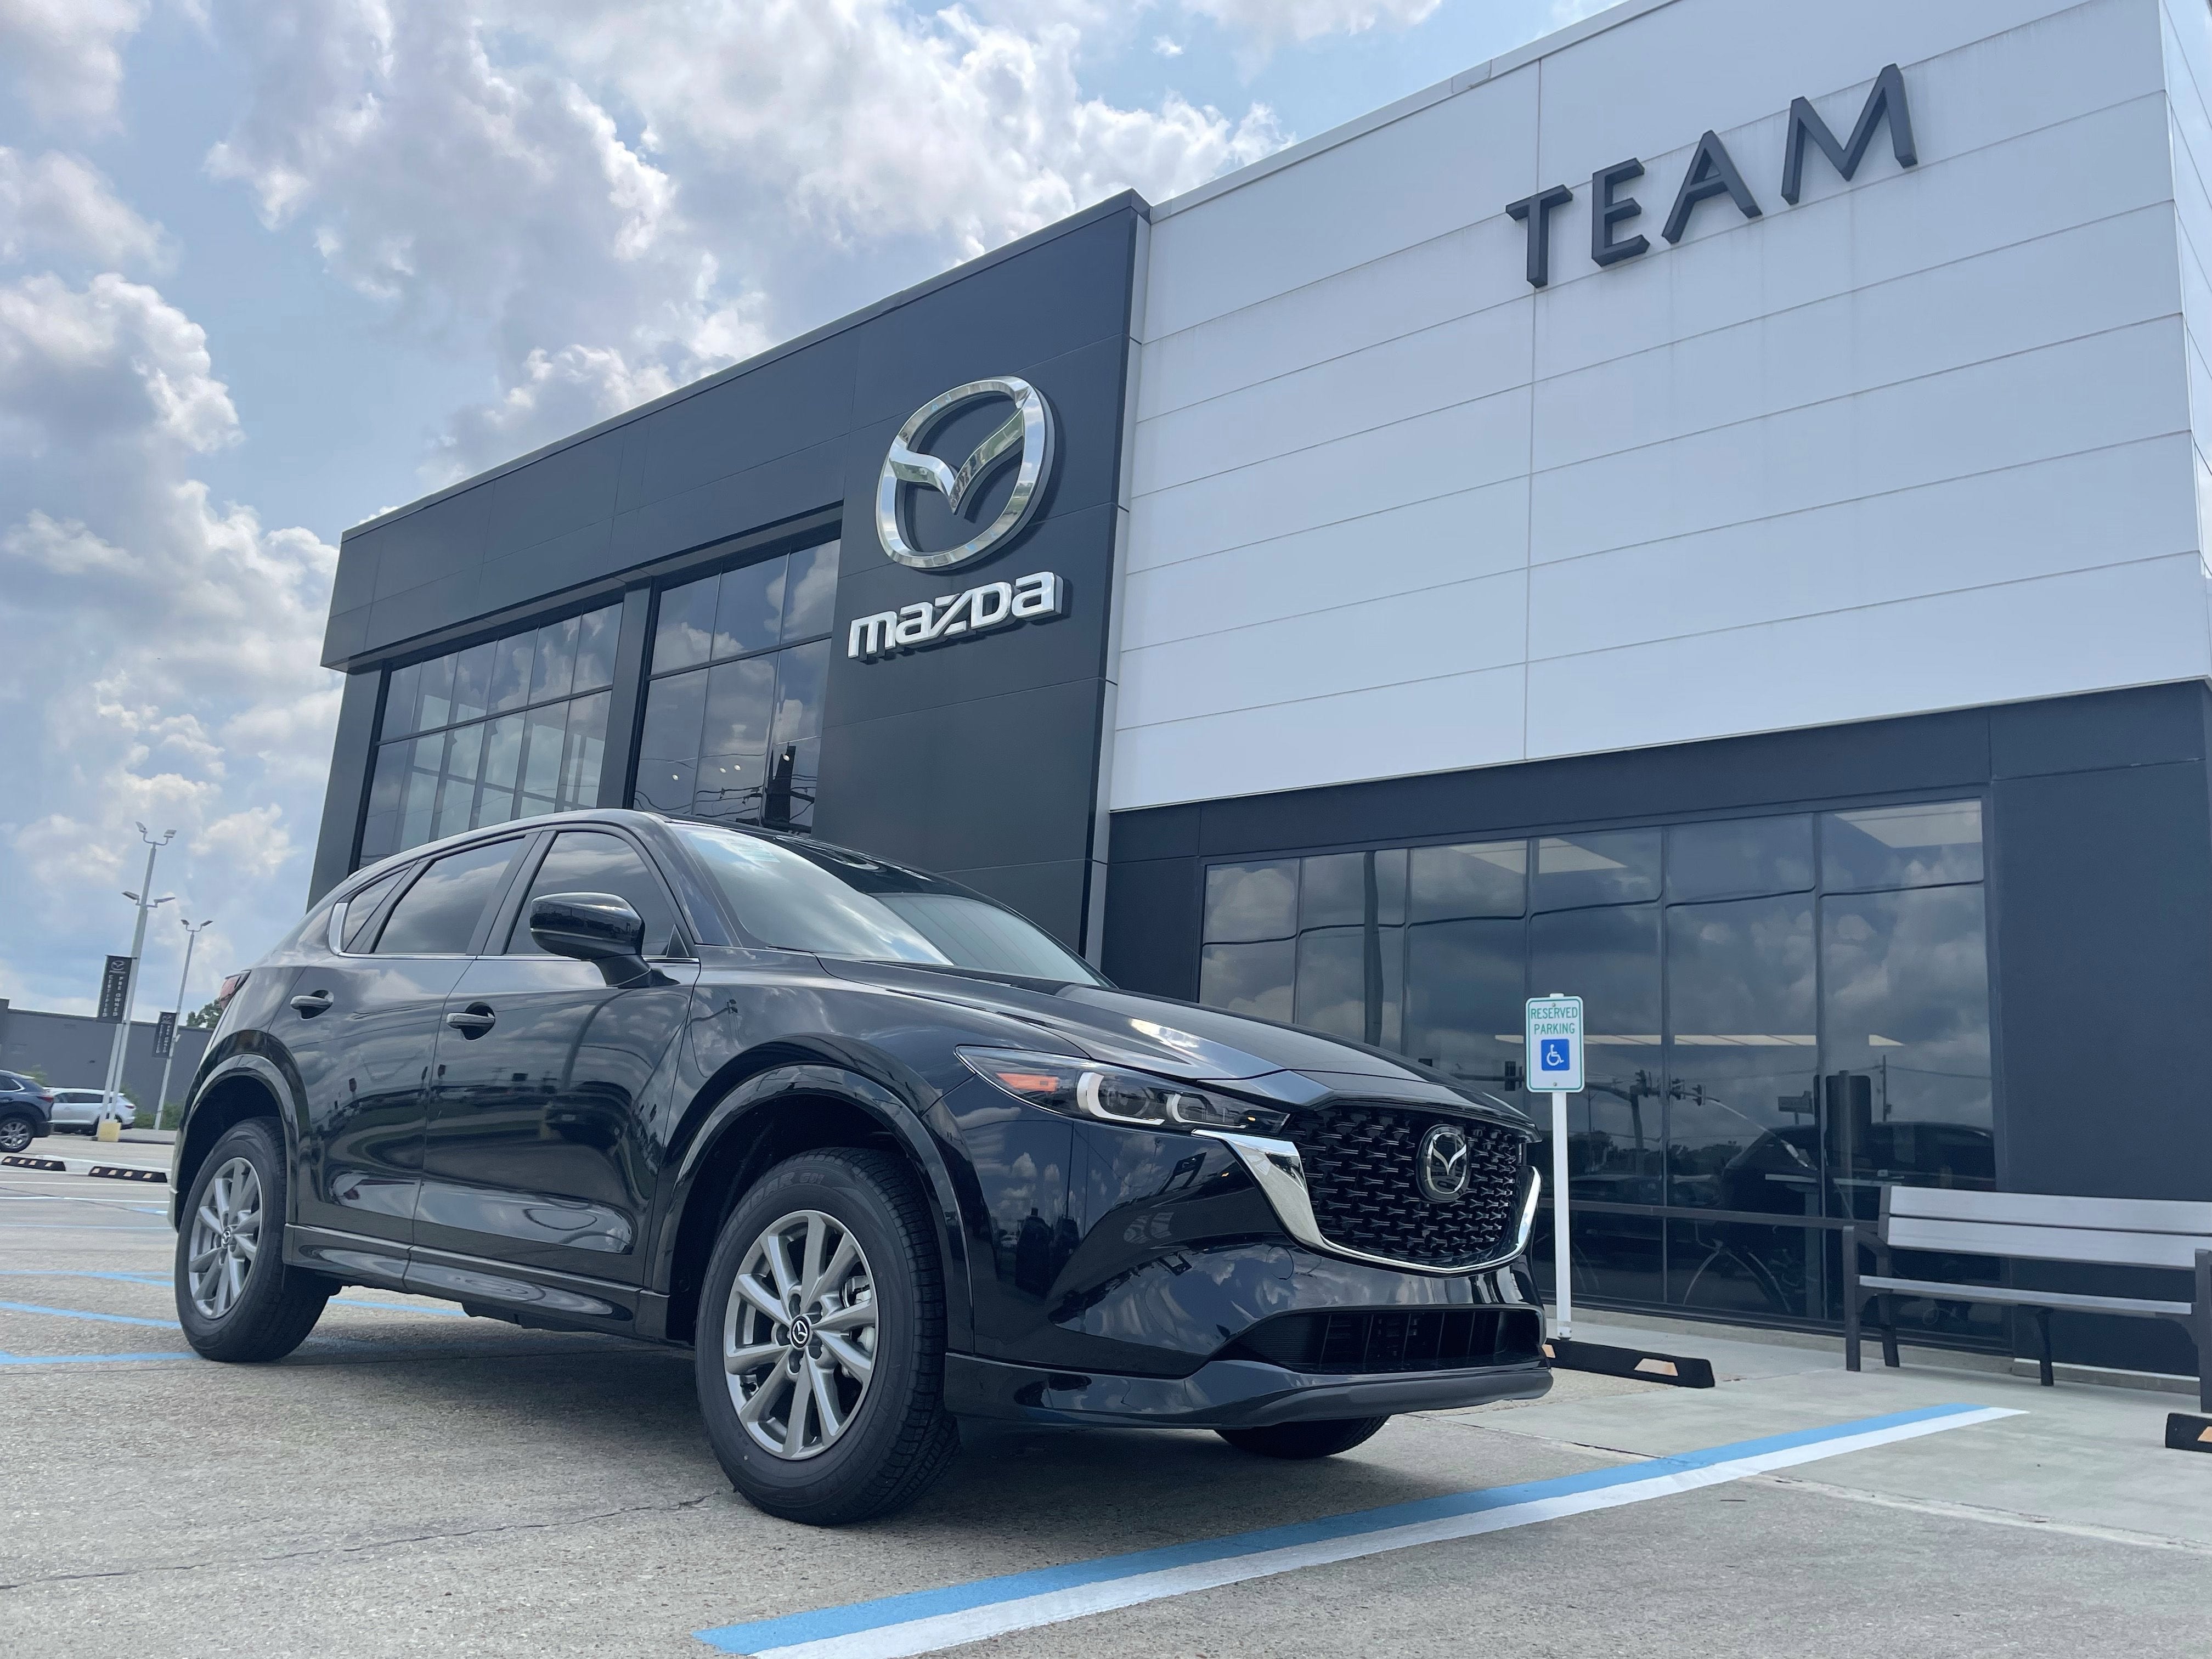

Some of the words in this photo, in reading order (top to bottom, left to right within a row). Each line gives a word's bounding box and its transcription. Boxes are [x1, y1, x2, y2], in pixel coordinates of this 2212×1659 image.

[1505, 63, 1918, 289] TEAM
[1531, 1007, 1578, 1019] RESERVED
[1534, 1023, 1575, 1035] PARKING
